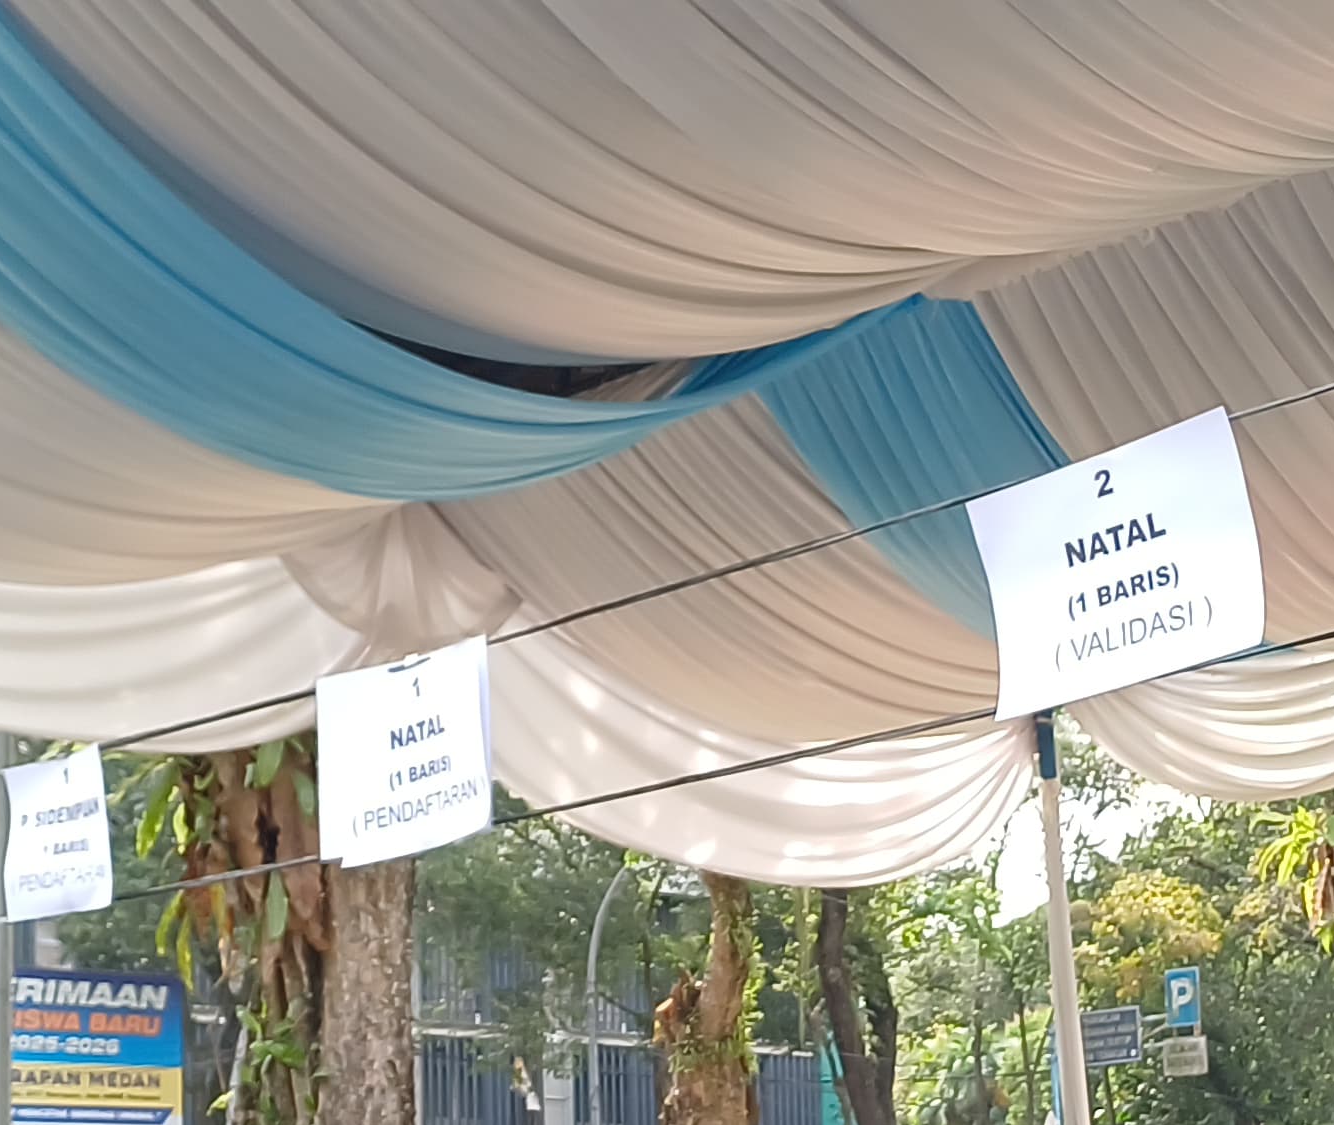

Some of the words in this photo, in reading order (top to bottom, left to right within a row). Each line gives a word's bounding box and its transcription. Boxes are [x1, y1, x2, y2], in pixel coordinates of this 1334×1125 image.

[1094, 469, 1114, 498] 2
[1064, 513, 1167, 568] NATAL
[1068, 592, 1088, 621] (1
[1096, 562, 1179, 607] BARIS)
[412, 677, 420, 697] 1
[390, 714, 445, 750] NATAL
[1170, 976, 1194, 1018] P
[88, 1012, 162, 1036] BARU
[88, 1071, 162, 1088] MEDAN
